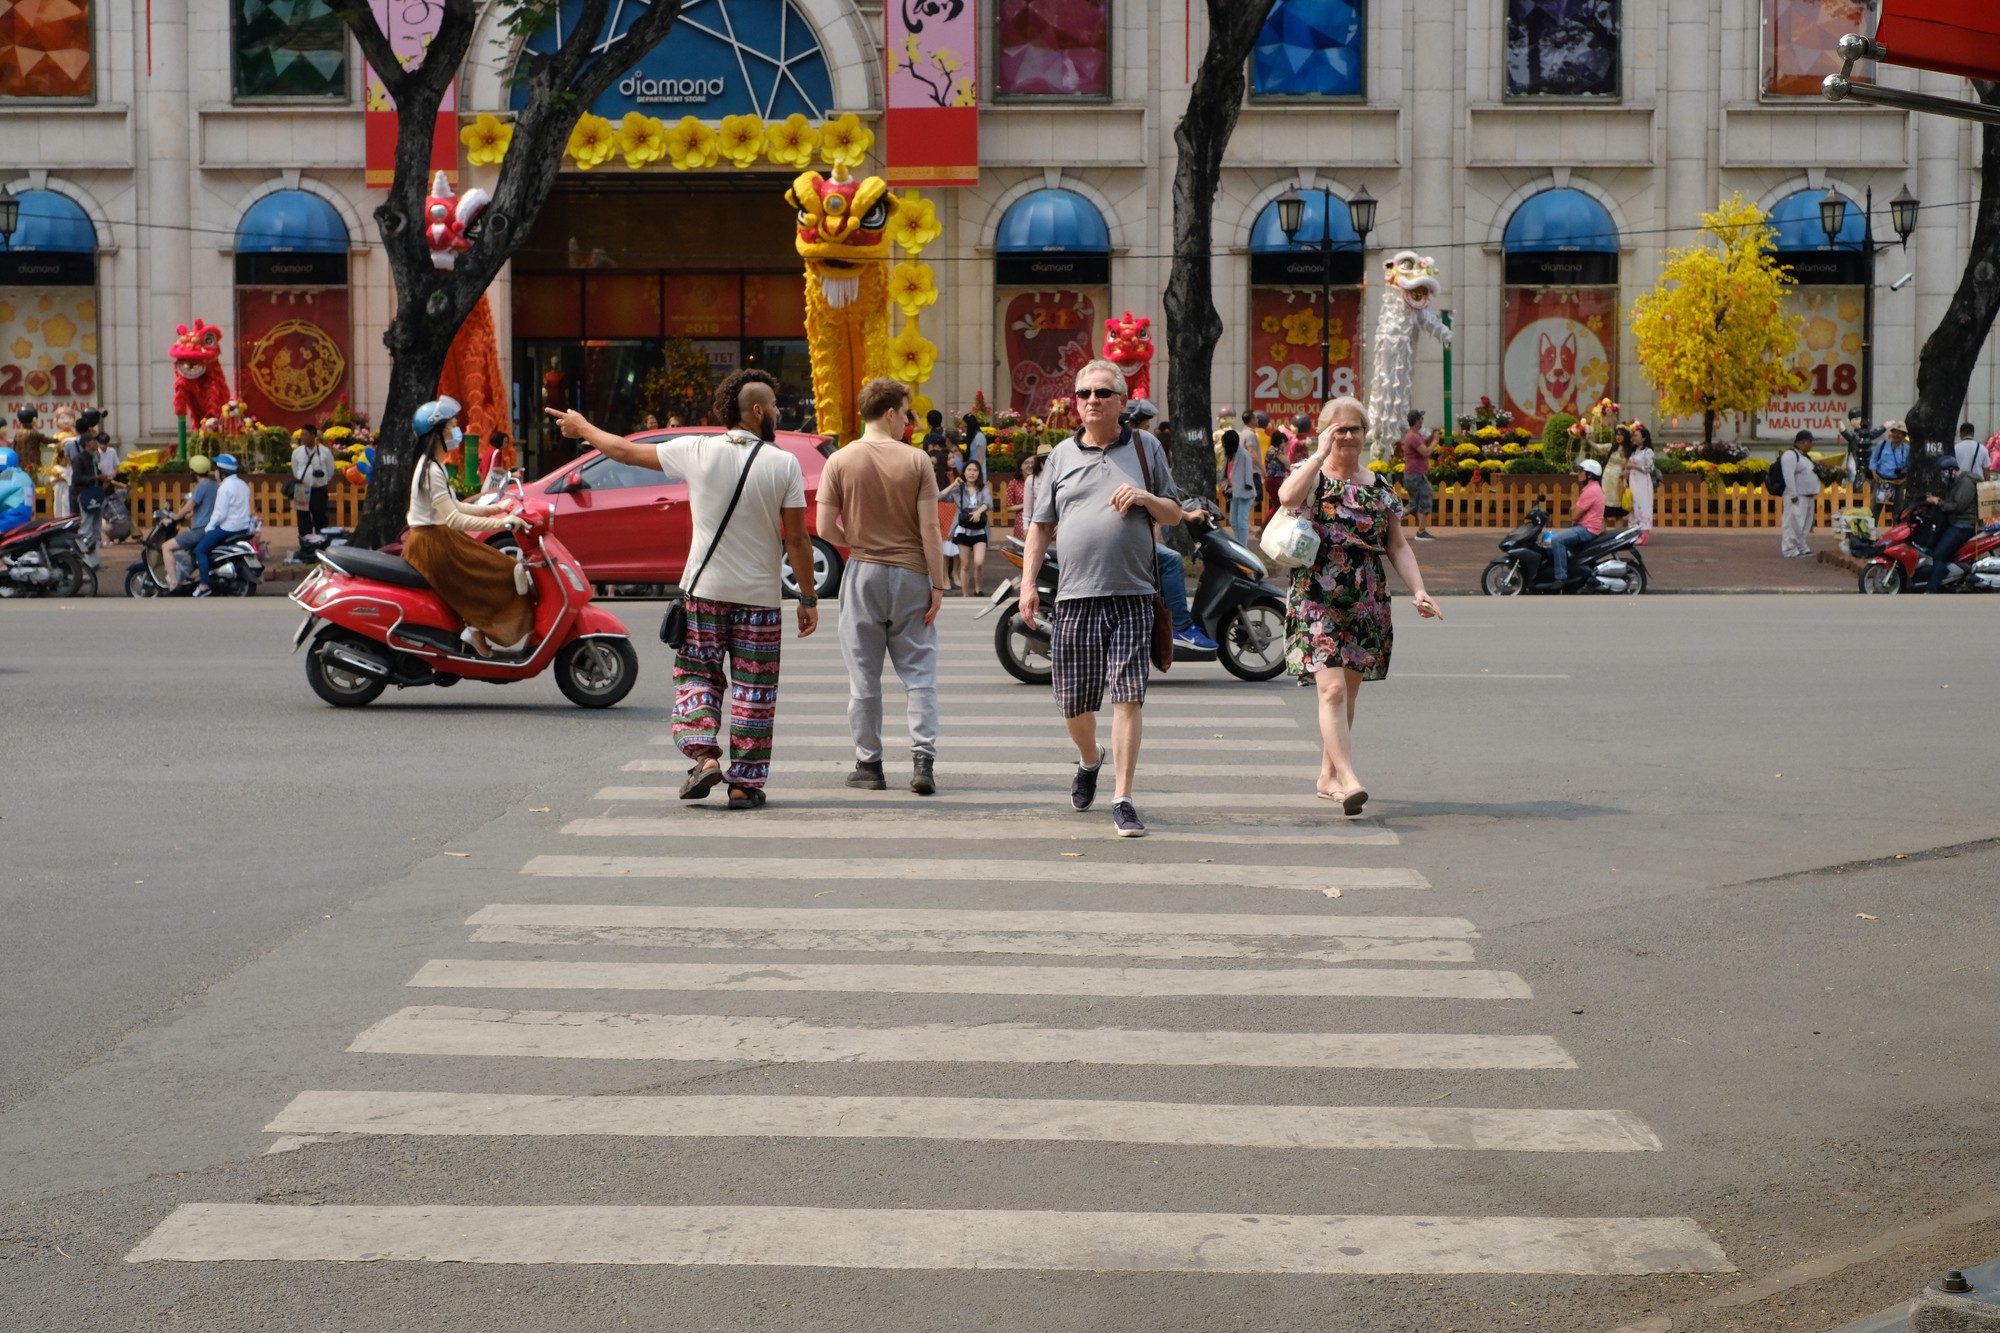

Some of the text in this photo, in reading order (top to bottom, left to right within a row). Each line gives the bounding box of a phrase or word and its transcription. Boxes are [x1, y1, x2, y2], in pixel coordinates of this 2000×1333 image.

[619, 70, 724, 96] diamond
[18, 262, 60, 273] diamond
[271, 262, 313, 273] diamond
[1032, 262, 1074, 272] diamond
[1287, 263, 1324, 273] diamon
[1540, 262, 1583, 272] diamond
[1795, 262, 1837, 272] diamond
[685, 323, 720, 334] 2018
[0, 364, 96, 397] 2018
[1254, 363, 1355, 400] 2018
[1925, 442, 1943, 453] 162
